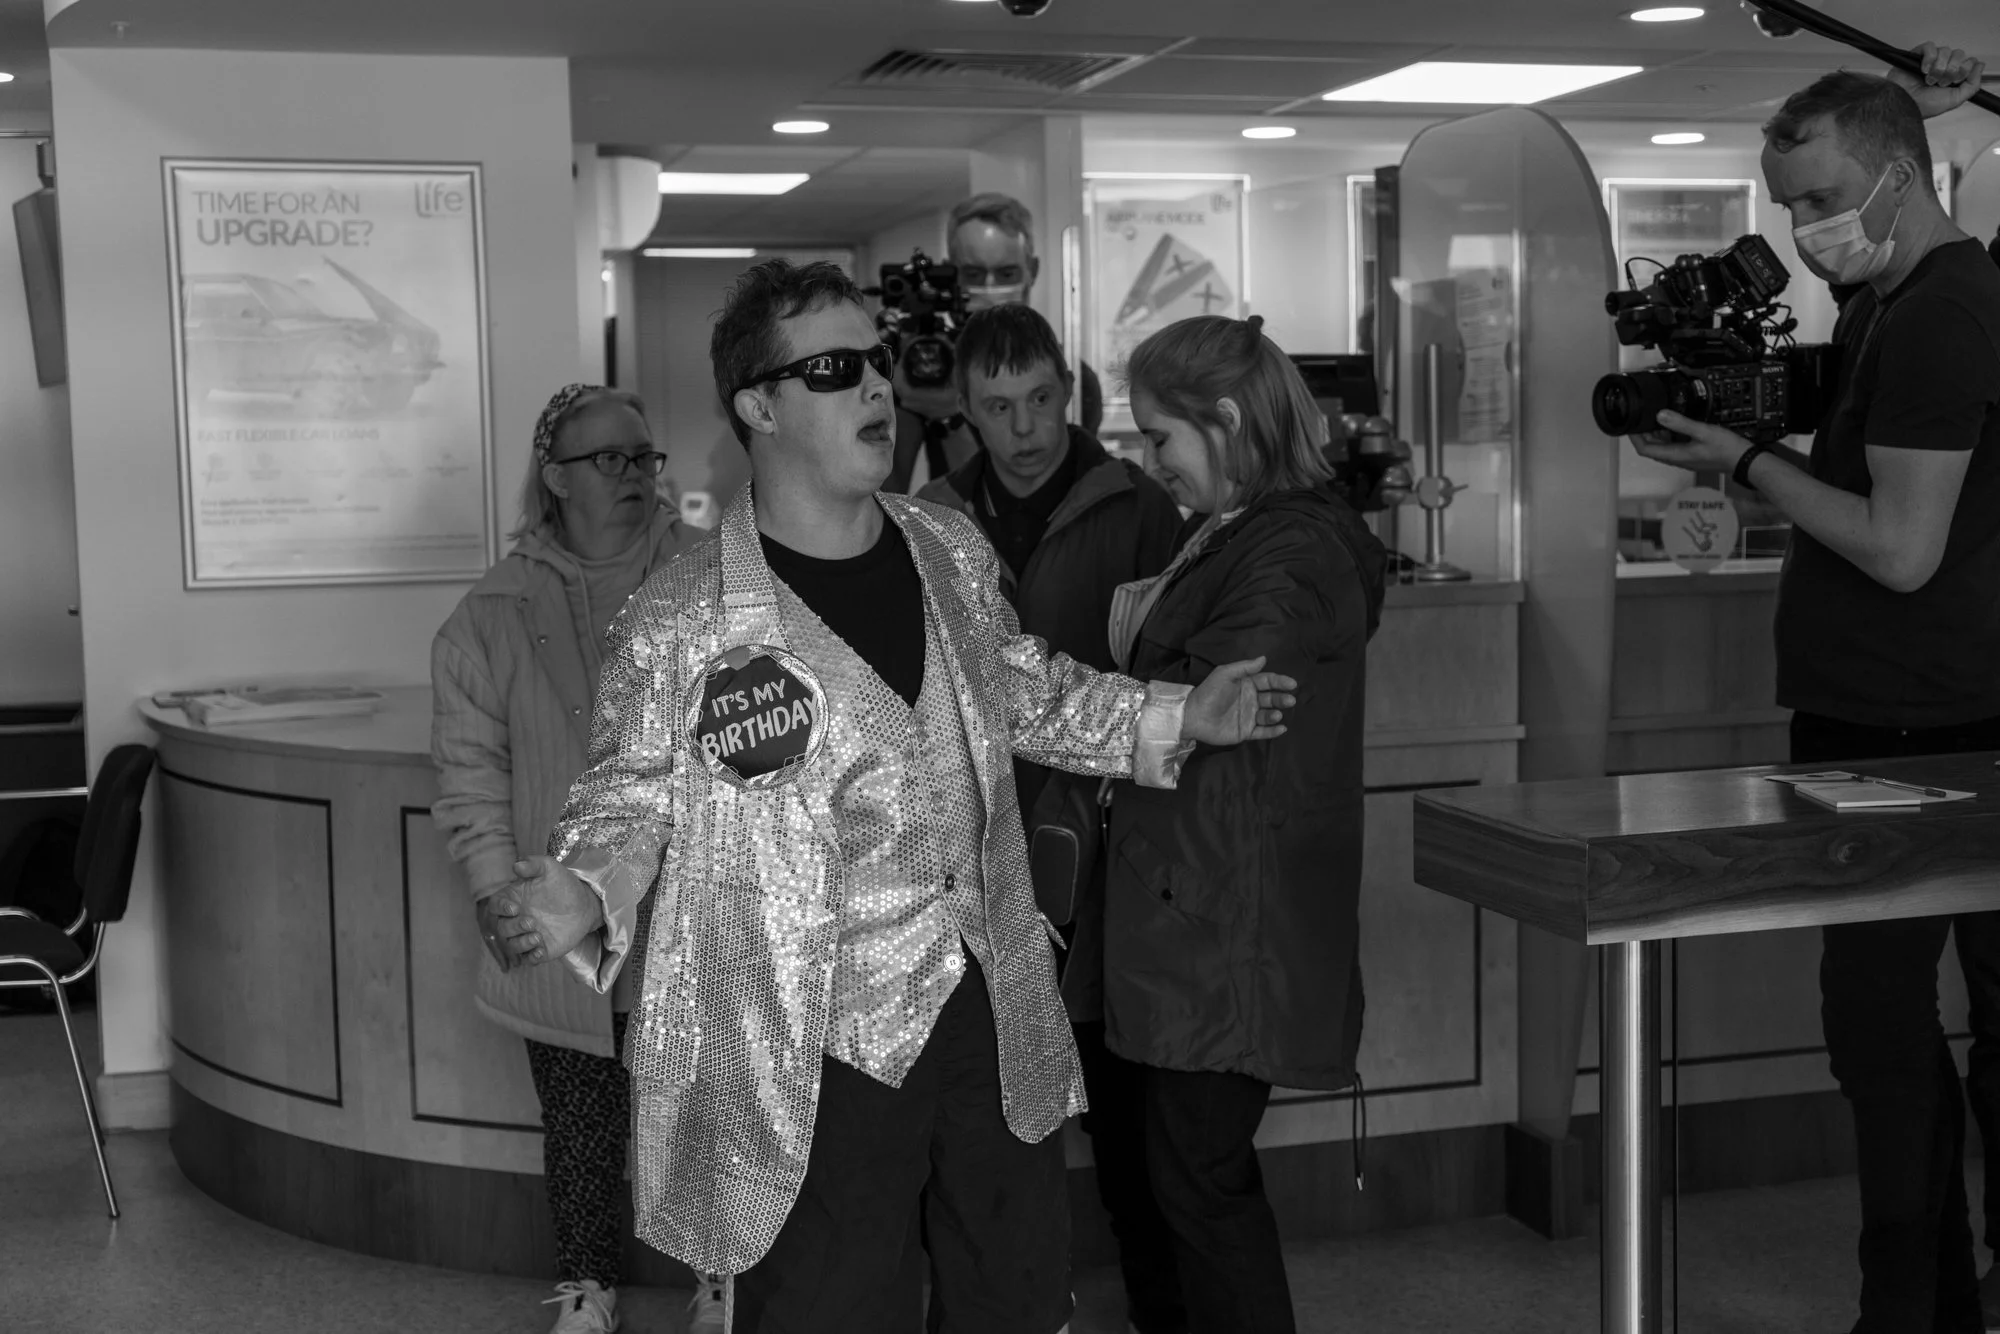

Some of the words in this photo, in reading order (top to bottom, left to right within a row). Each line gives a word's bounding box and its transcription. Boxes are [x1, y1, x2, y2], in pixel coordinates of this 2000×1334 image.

[191, 190, 260, 214] TIME
[262, 190, 319, 215] FOR
[321, 190, 360, 214] AN
[196, 218, 375, 247] UPGRADE?
[712, 690, 749, 718] IT'S
[752, 678, 786, 706] MY
[701, 692, 819, 762] BIRTHDAY
